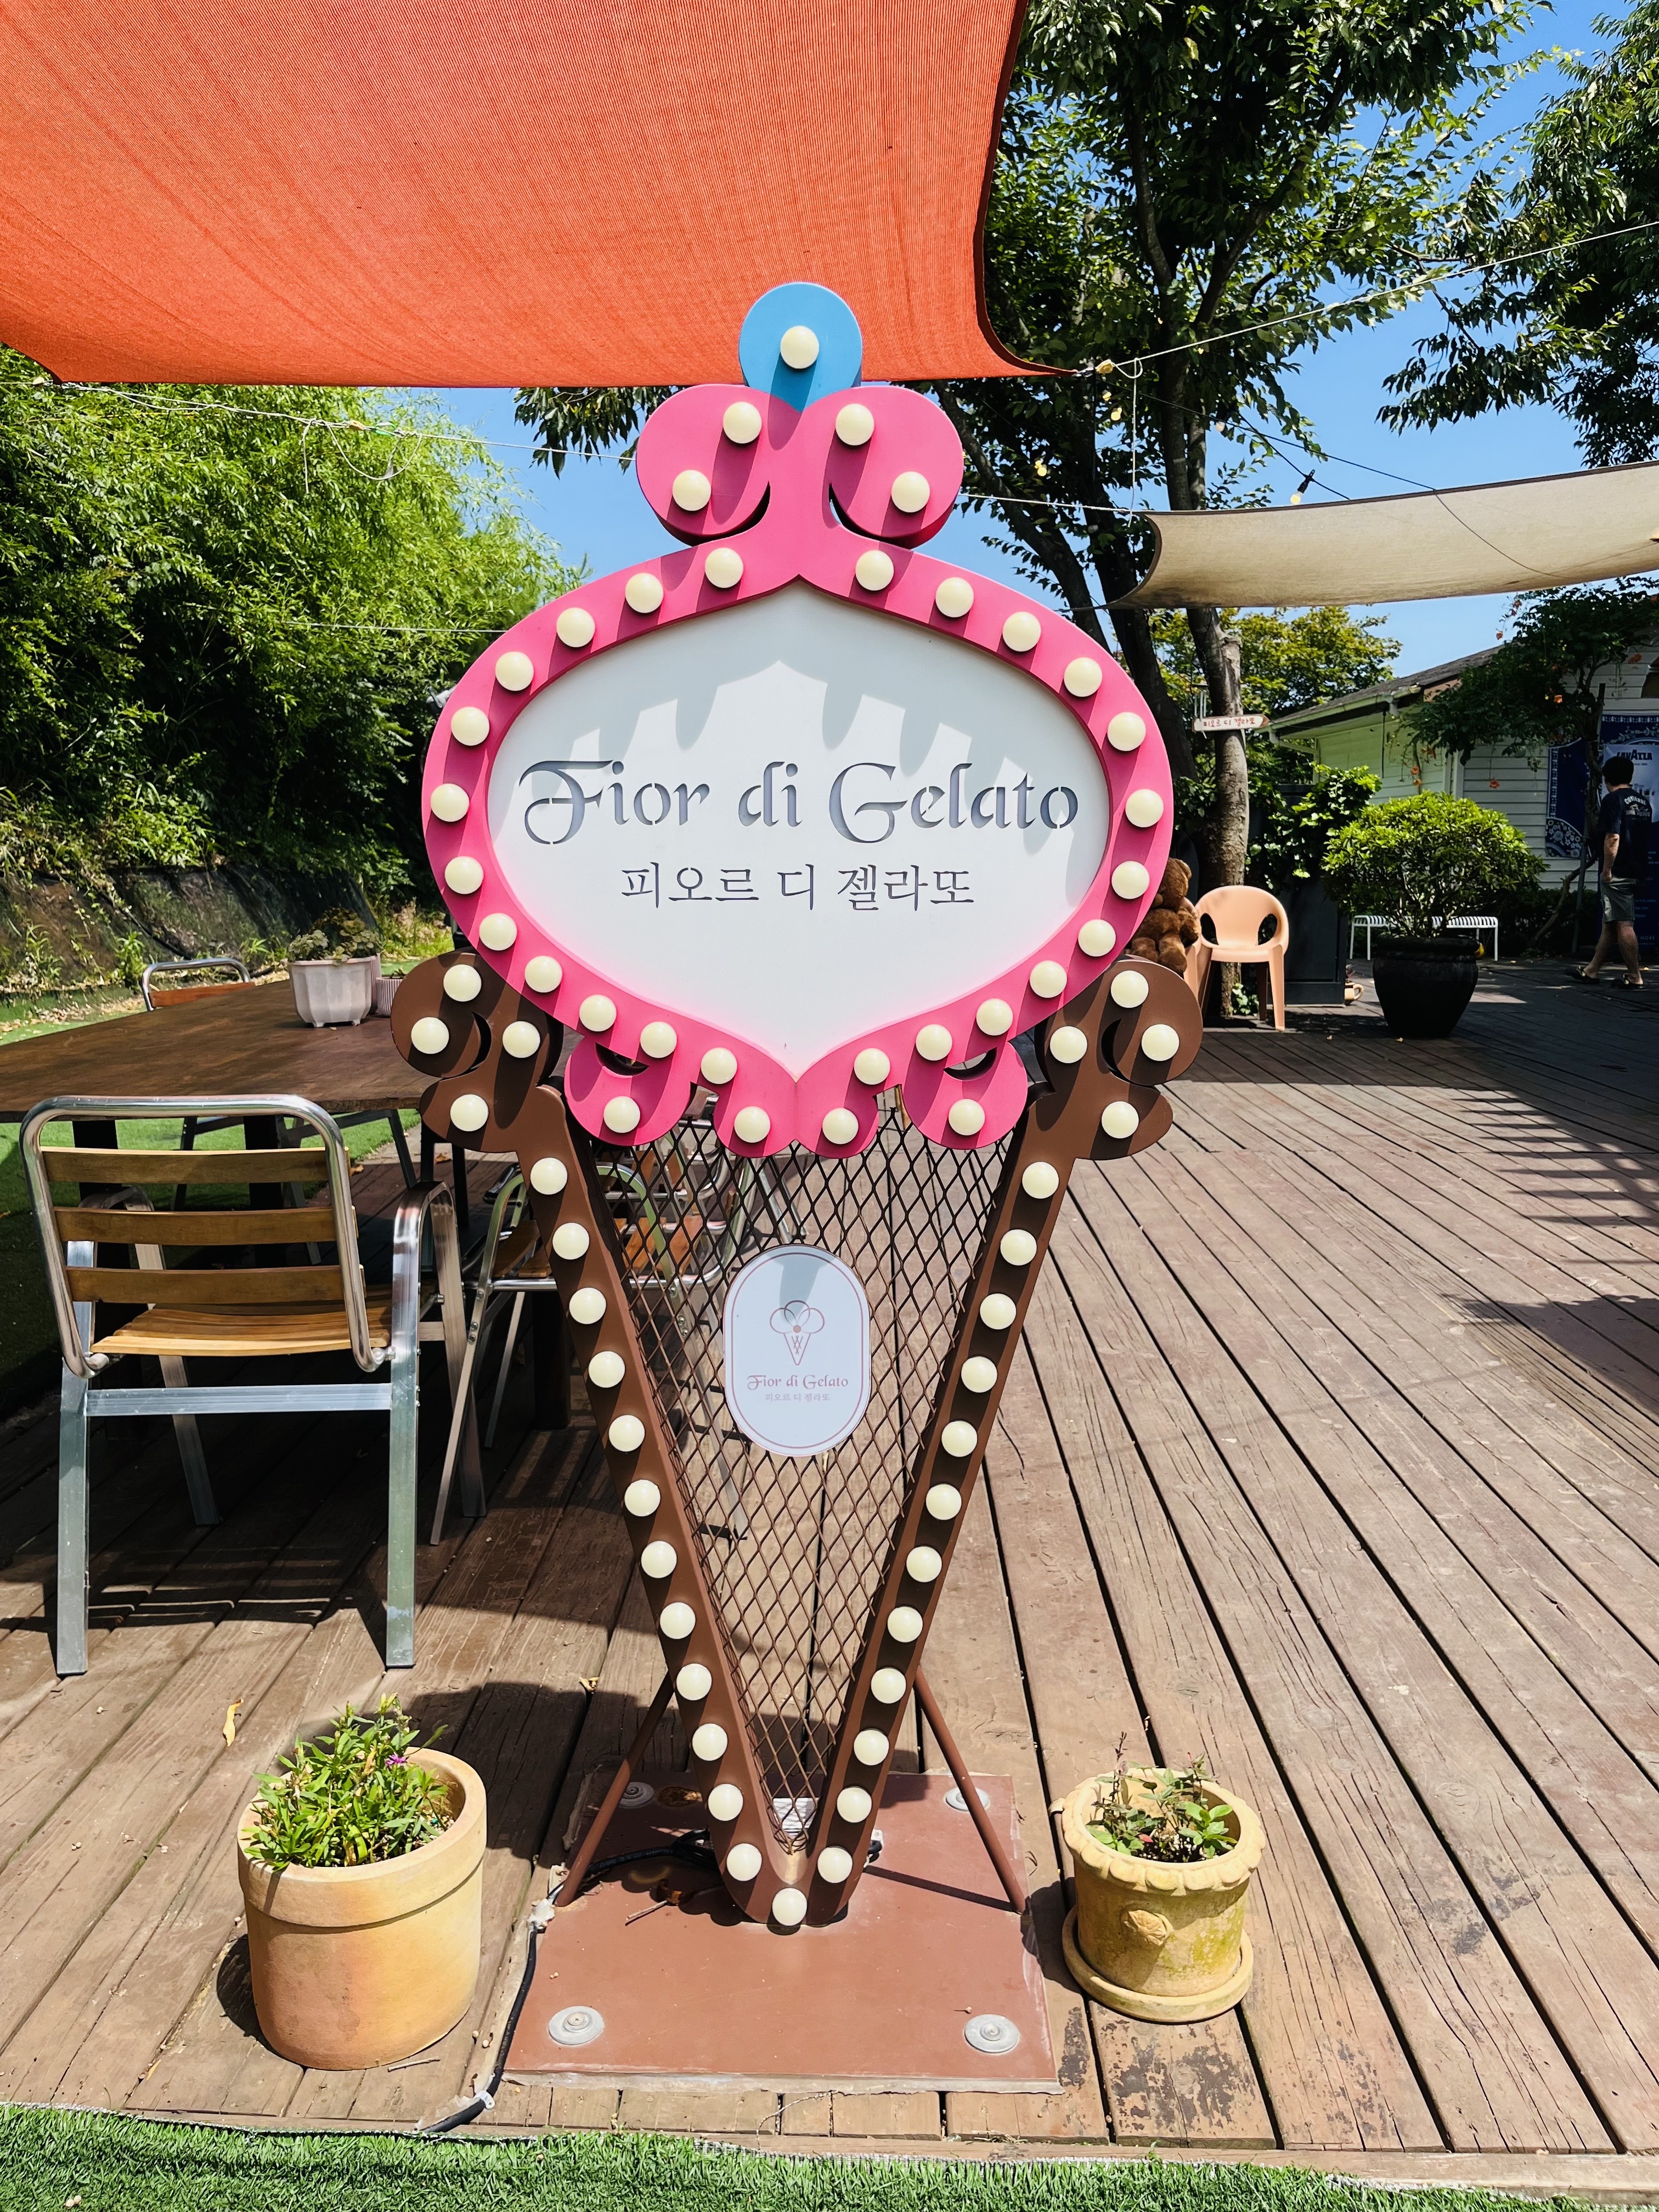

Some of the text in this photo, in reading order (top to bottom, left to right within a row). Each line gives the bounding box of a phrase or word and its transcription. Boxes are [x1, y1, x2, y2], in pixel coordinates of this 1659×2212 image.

[1203, 718, 1221, 727] 피오르
[518, 759, 1078, 845] Fior di Gelato
[621, 861, 974, 912] 피오르 디 젤라또
[746, 1374, 849, 1390] Fior di Gelato
[765, 1392, 830, 1402] 피오르 디 젤라또
